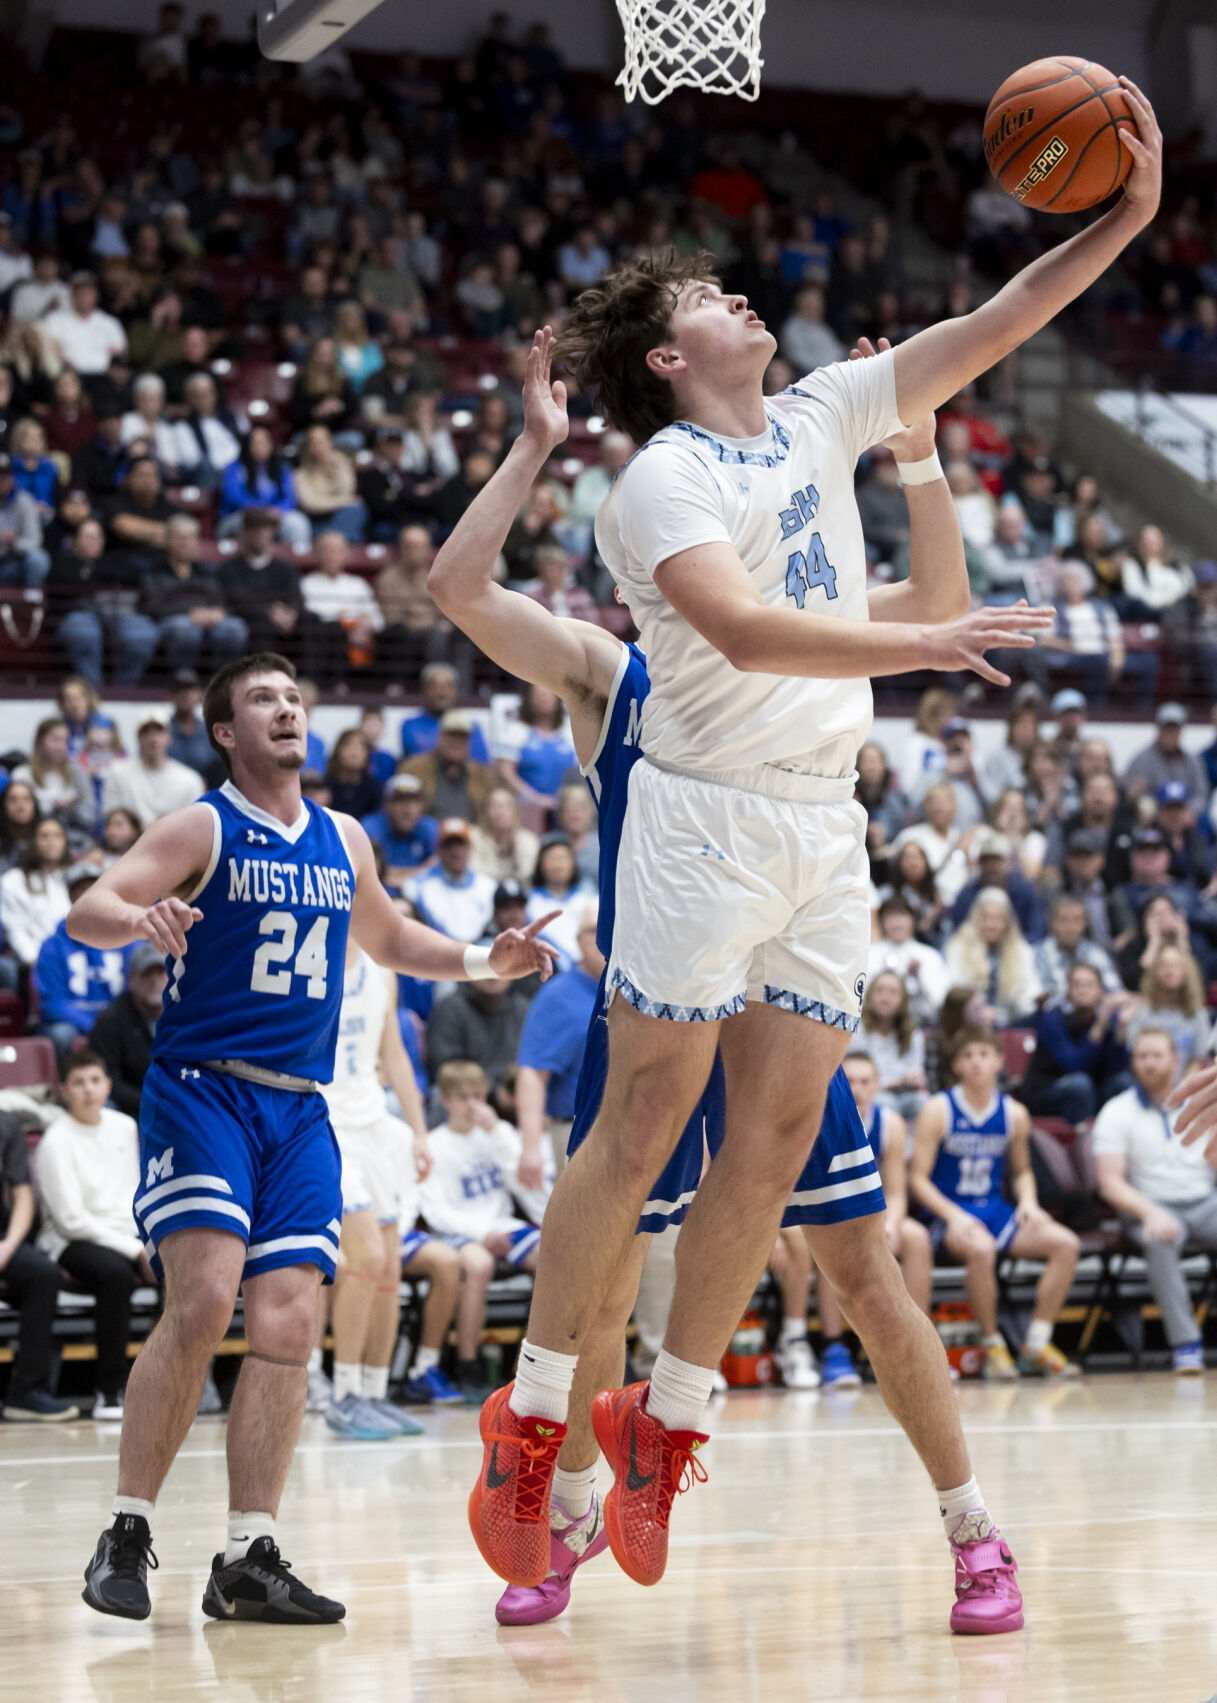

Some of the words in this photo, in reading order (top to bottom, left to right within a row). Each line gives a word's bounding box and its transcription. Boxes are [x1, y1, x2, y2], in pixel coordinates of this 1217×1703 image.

[785, 531, 838, 609] 44
[228, 857, 351, 912] MUSTANGS
[250, 910, 330, 1000] 24
[146, 1146, 174, 1189] M
